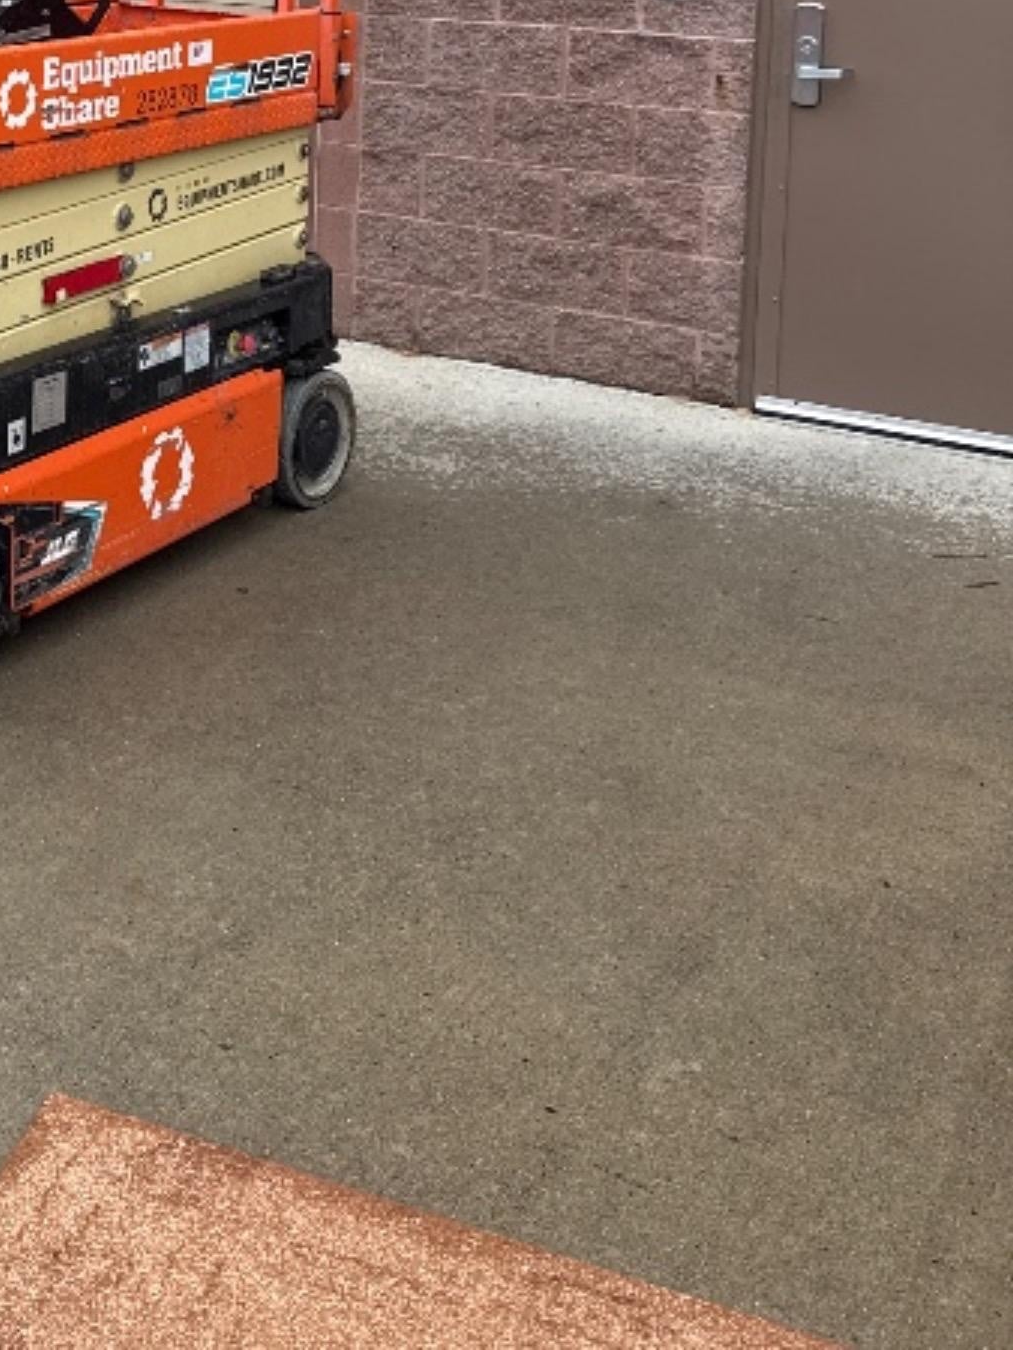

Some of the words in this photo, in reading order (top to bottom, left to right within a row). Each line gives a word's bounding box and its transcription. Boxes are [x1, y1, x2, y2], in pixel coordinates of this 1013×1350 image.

[43, 41, 184, 93] Equipment
[205, 51, 315, 104] ES1932
[41, 96, 120, 130] Share
